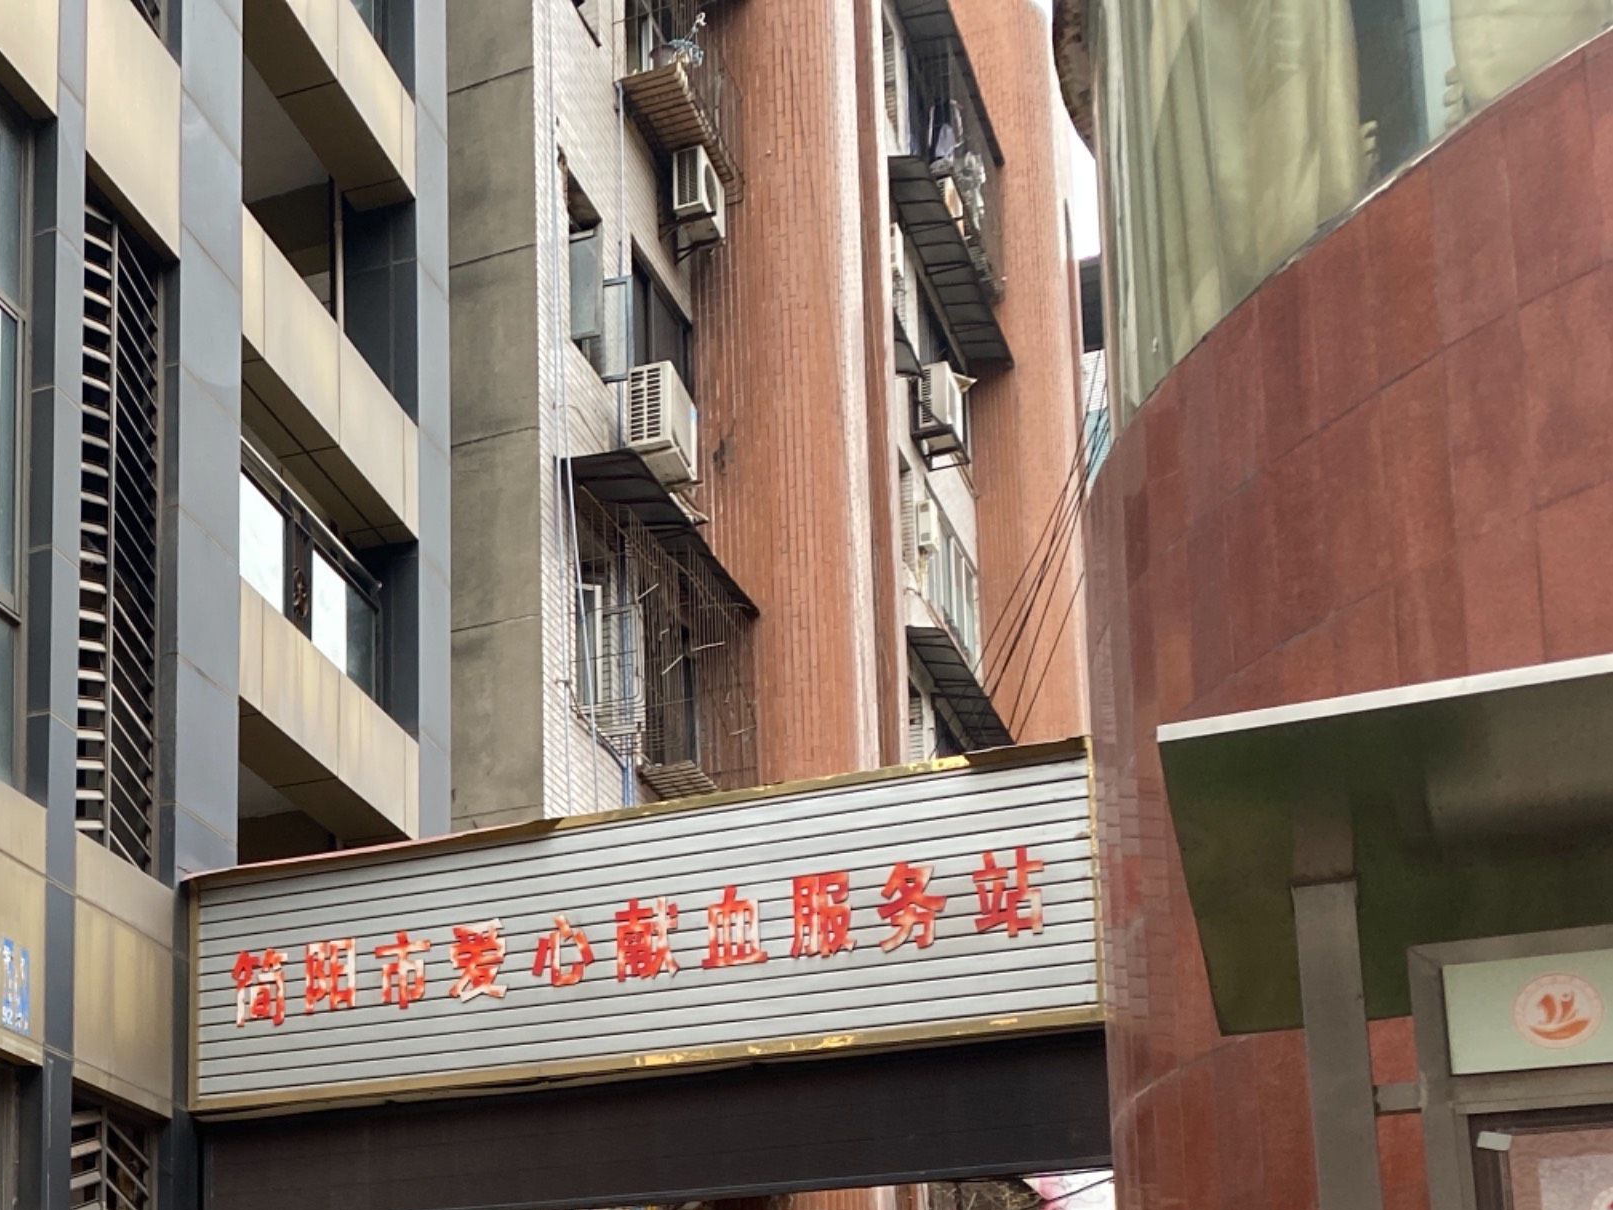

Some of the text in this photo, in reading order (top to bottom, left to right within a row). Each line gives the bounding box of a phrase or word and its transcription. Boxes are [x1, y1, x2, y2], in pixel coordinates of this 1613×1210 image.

[231, 845, 1046, 1029] 简阳市爱心献血服务站
